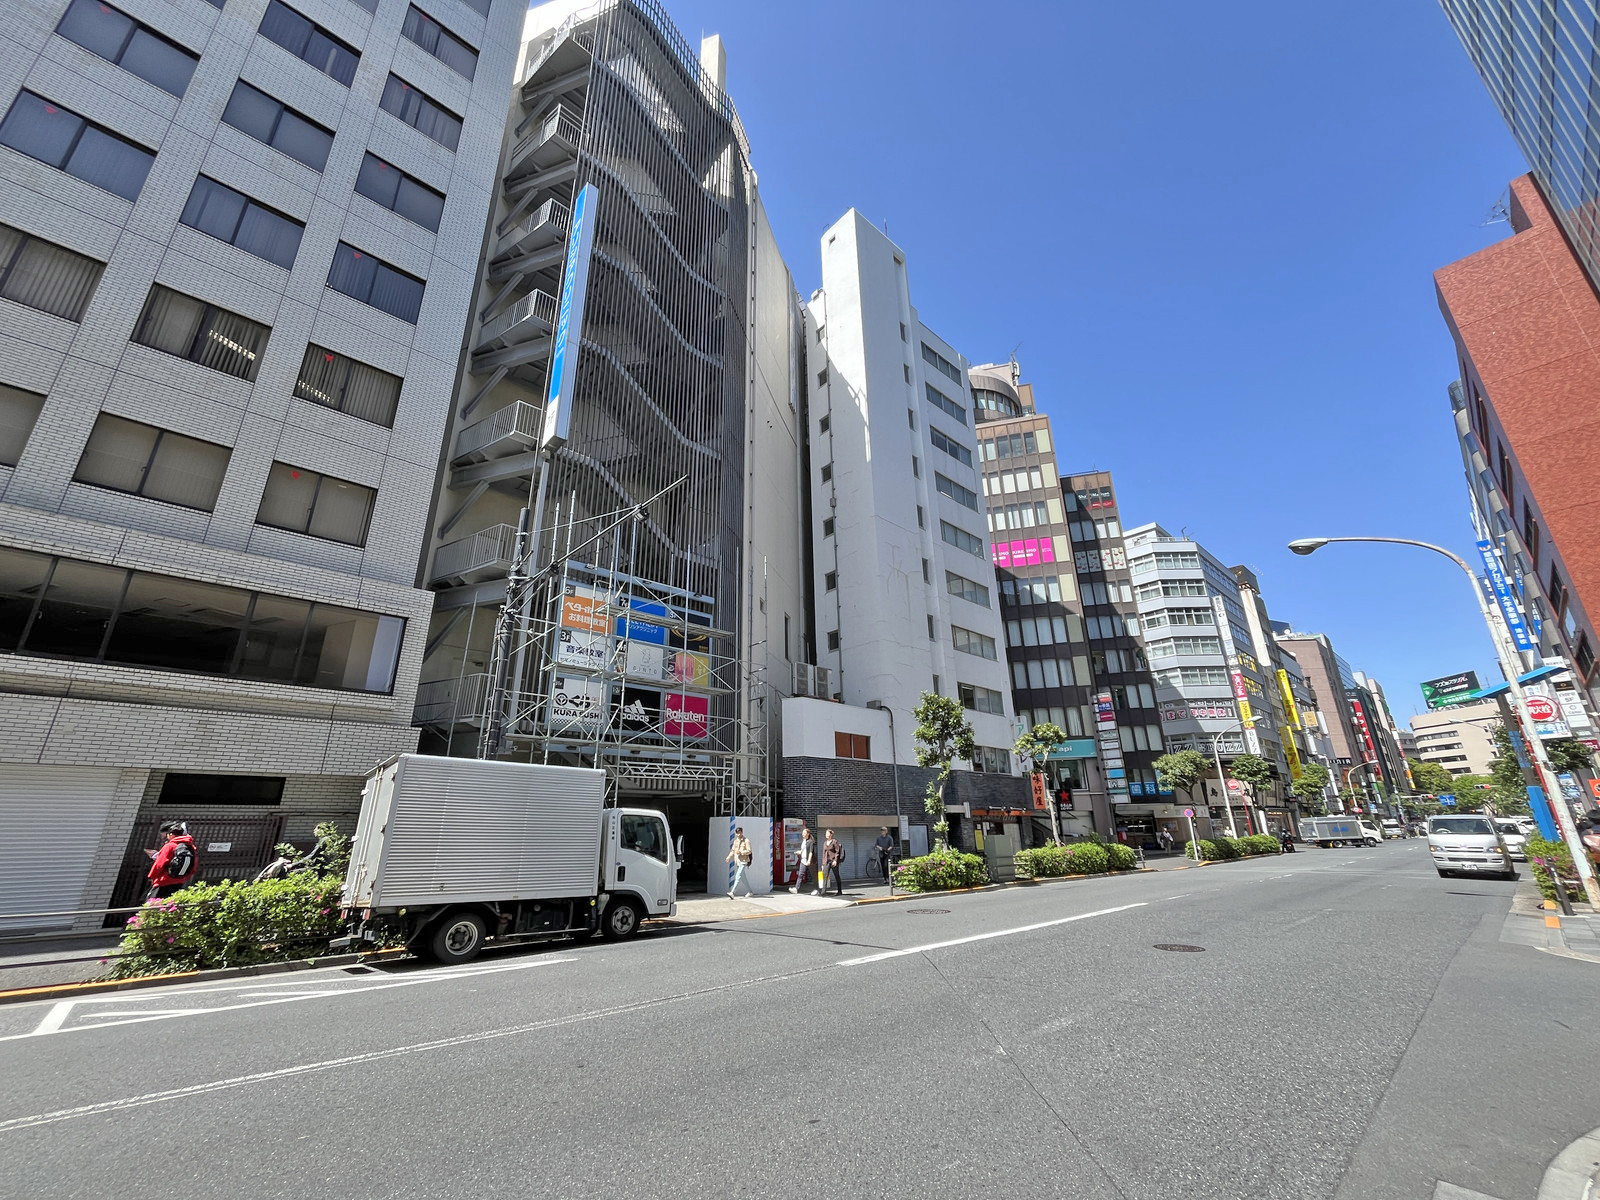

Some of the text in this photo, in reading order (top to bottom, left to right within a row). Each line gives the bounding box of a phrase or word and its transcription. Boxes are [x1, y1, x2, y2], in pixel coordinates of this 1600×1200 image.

[560, 631, 571, 641] 3F
[553, 708, 577, 718] KURA
[621, 711, 649, 722] adidas
[666, 708, 705, 722] Rakuten
[1131, 784, 1156, 795] 歯科
